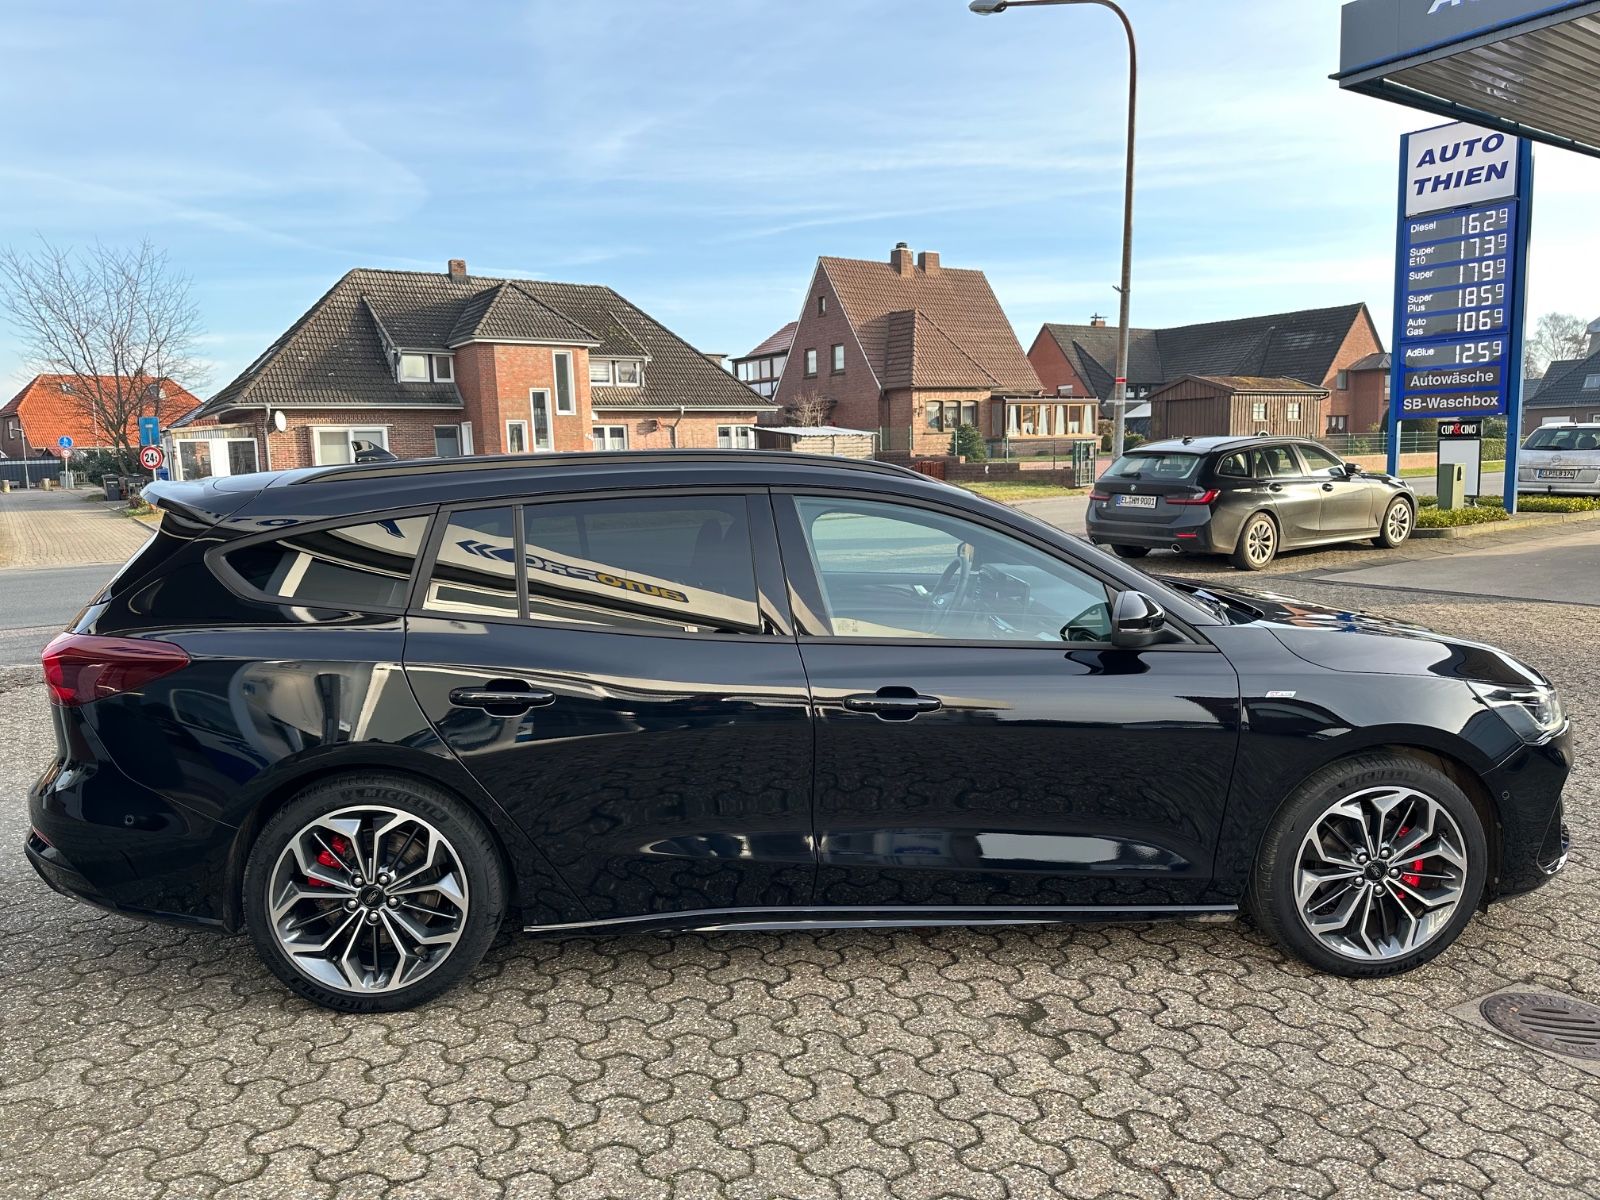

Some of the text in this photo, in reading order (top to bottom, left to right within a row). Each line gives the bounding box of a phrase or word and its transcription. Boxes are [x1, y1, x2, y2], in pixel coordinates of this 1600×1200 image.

[1416, 133, 1504, 168] AUTO
[1413, 160, 1509, 195] THIEN
[1410, 221, 1436, 233] Diesel
[1409, 246, 1435, 257] Super
[1409, 256, 1426, 266] E10
[1408, 270, 1434, 281] Super
[1407, 293, 1433, 304] Super
[1407, 304, 1426, 313] Plus
[1406, 318, 1427, 327] Auto
[1406, 328, 1424, 336] Gas
[1405, 347, 1435, 357] AdBlue
[1410, 371, 1494, 387] Autowäsche
[1403, 395, 1498, 410] SB-Waschbox
